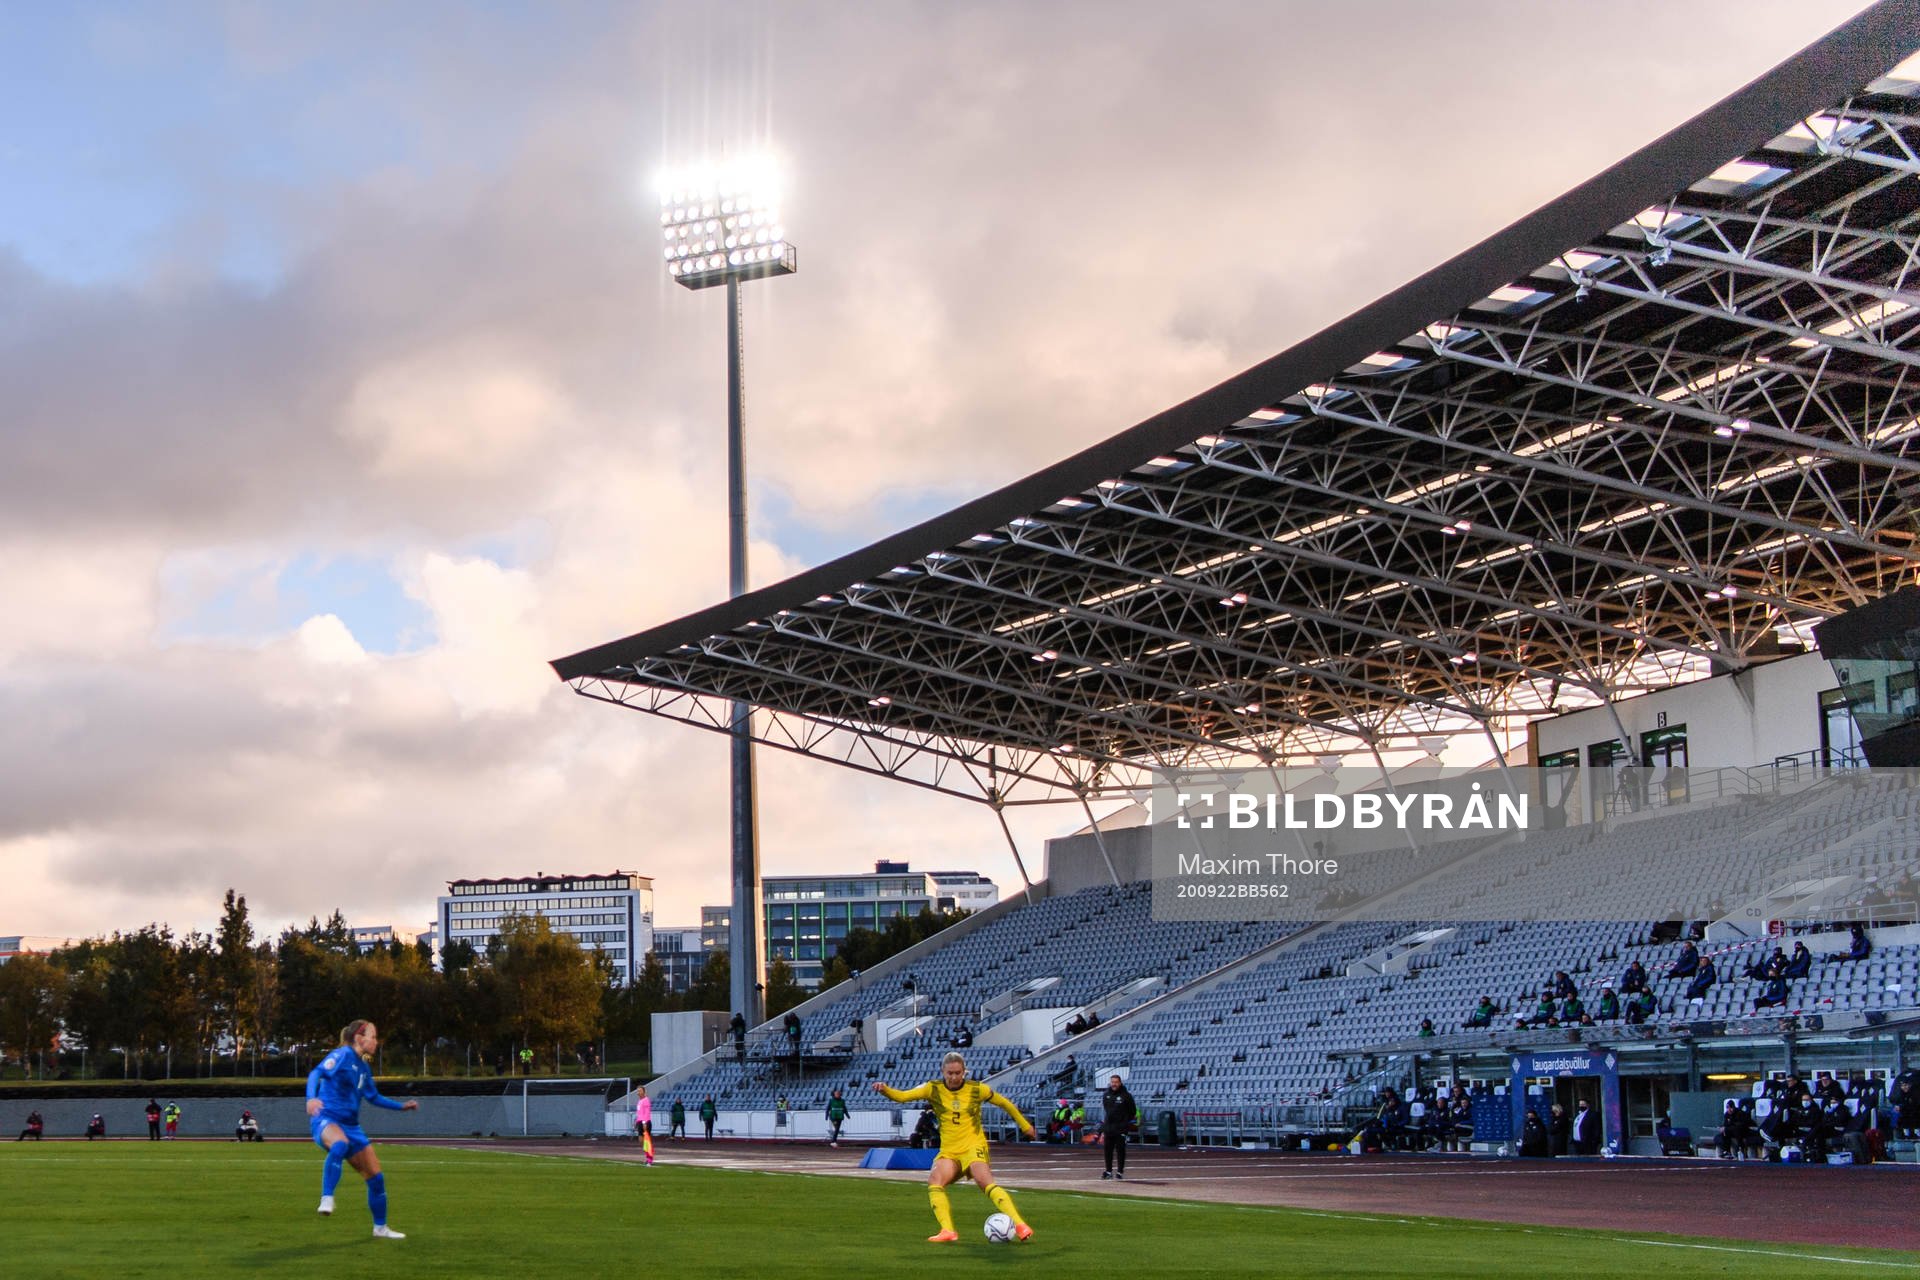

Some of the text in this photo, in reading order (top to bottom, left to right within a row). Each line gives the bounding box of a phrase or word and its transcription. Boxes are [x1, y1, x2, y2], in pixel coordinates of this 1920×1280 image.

[1659, 713, 1665, 727] B
[1746, 908, 1761, 917] CD
[952, 1112, 960, 1125] 2
